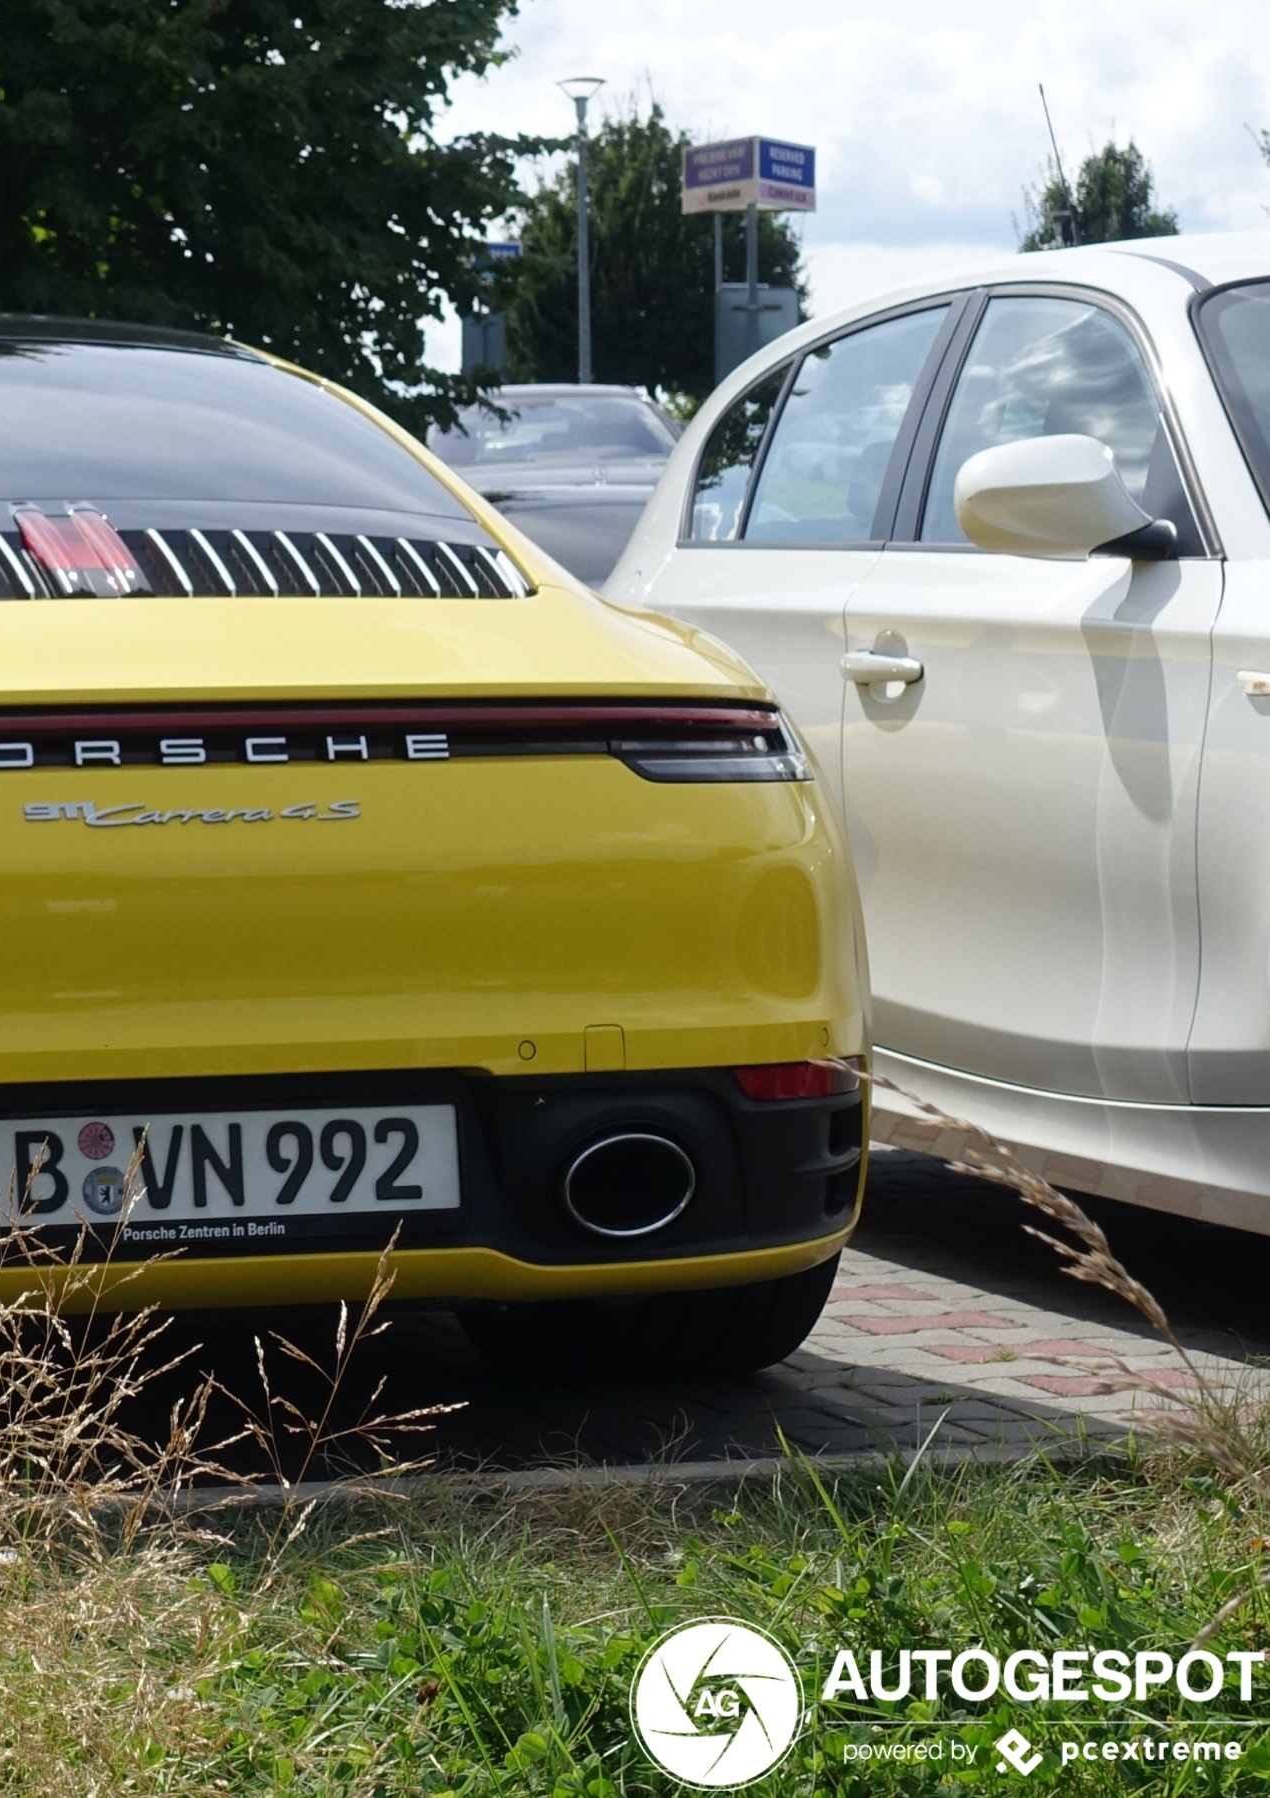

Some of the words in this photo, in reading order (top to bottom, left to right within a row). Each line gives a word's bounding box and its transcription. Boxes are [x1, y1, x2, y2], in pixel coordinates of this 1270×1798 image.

[771, 162, 803, 181] PARKING
[24, 802, 95, 821] 911
[85, 802, 275, 827] Carrera
[14, 1130, 69, 1214] B
[132, 1122, 245, 1210] VN
[265, 1117, 423, 1204] 992
[123, 1226, 176, 1241] Porsche
[179, 1225, 230, 1239] Zentren
[233, 1223, 245, 1236] in
[247, 1222, 285, 1236] Berlin
